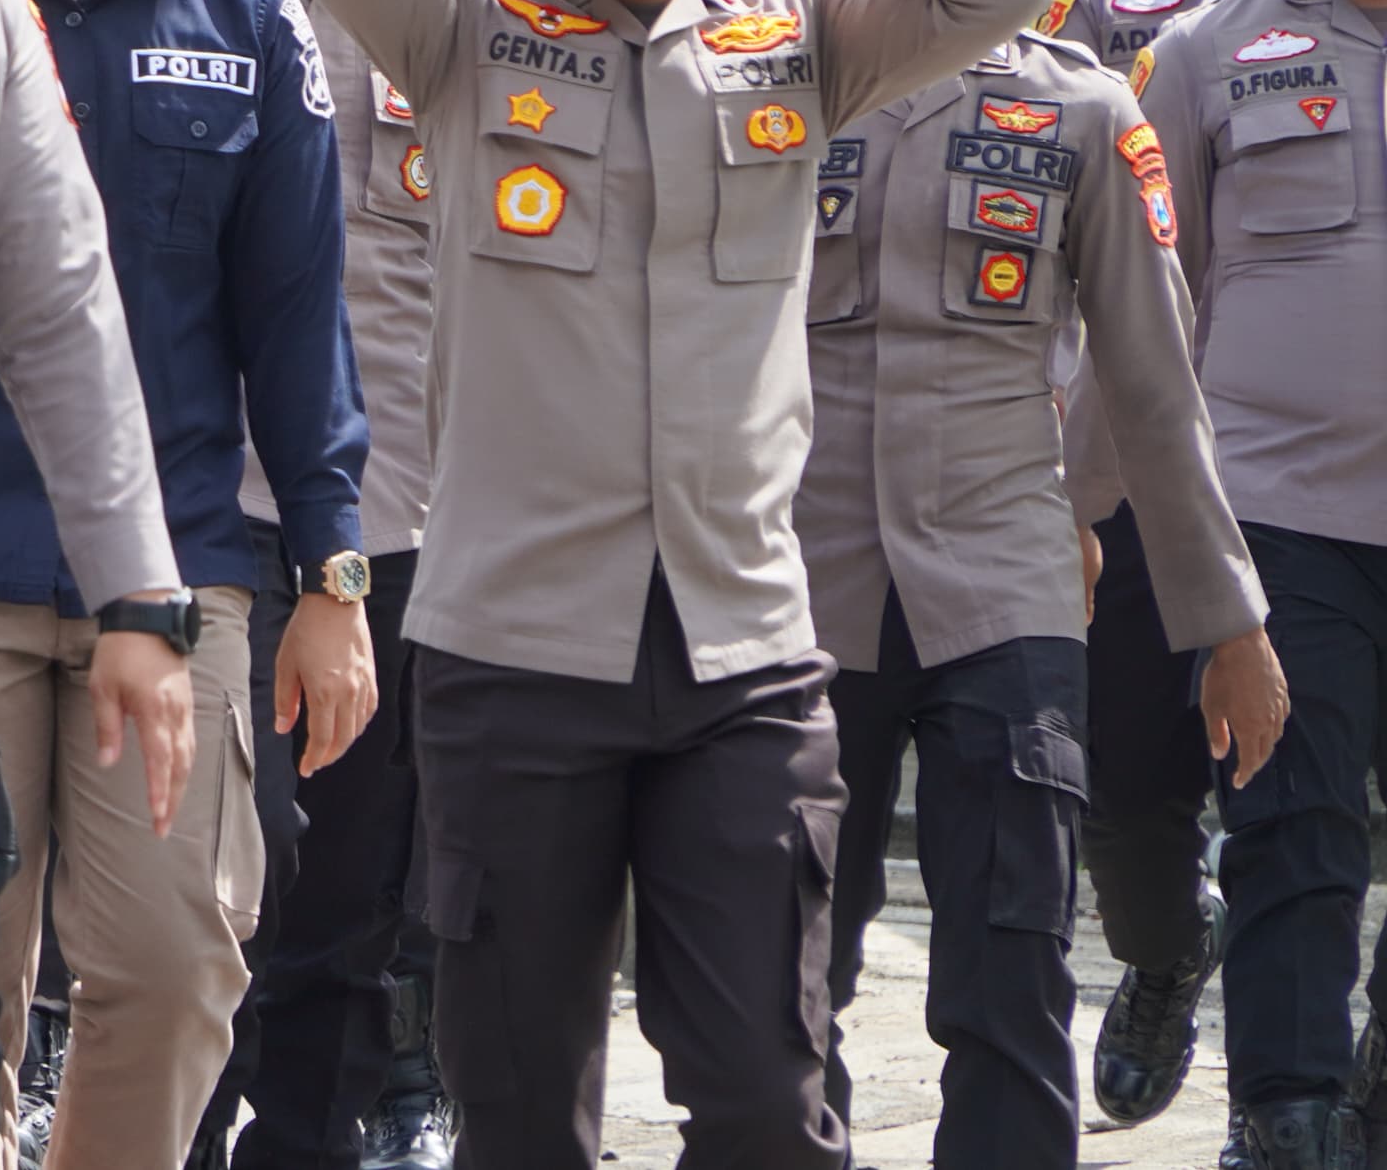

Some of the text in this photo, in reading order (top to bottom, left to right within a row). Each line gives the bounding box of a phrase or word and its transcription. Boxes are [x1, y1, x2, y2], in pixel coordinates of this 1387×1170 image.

[147, 55, 237, 85] POLRI
[489, 31, 607, 84] GENTA.S
[714, 53, 813, 86] POLRI
[1230, 63, 1338, 101] D.FIGUR.A
[955, 139, 1069, 184] POLRI
